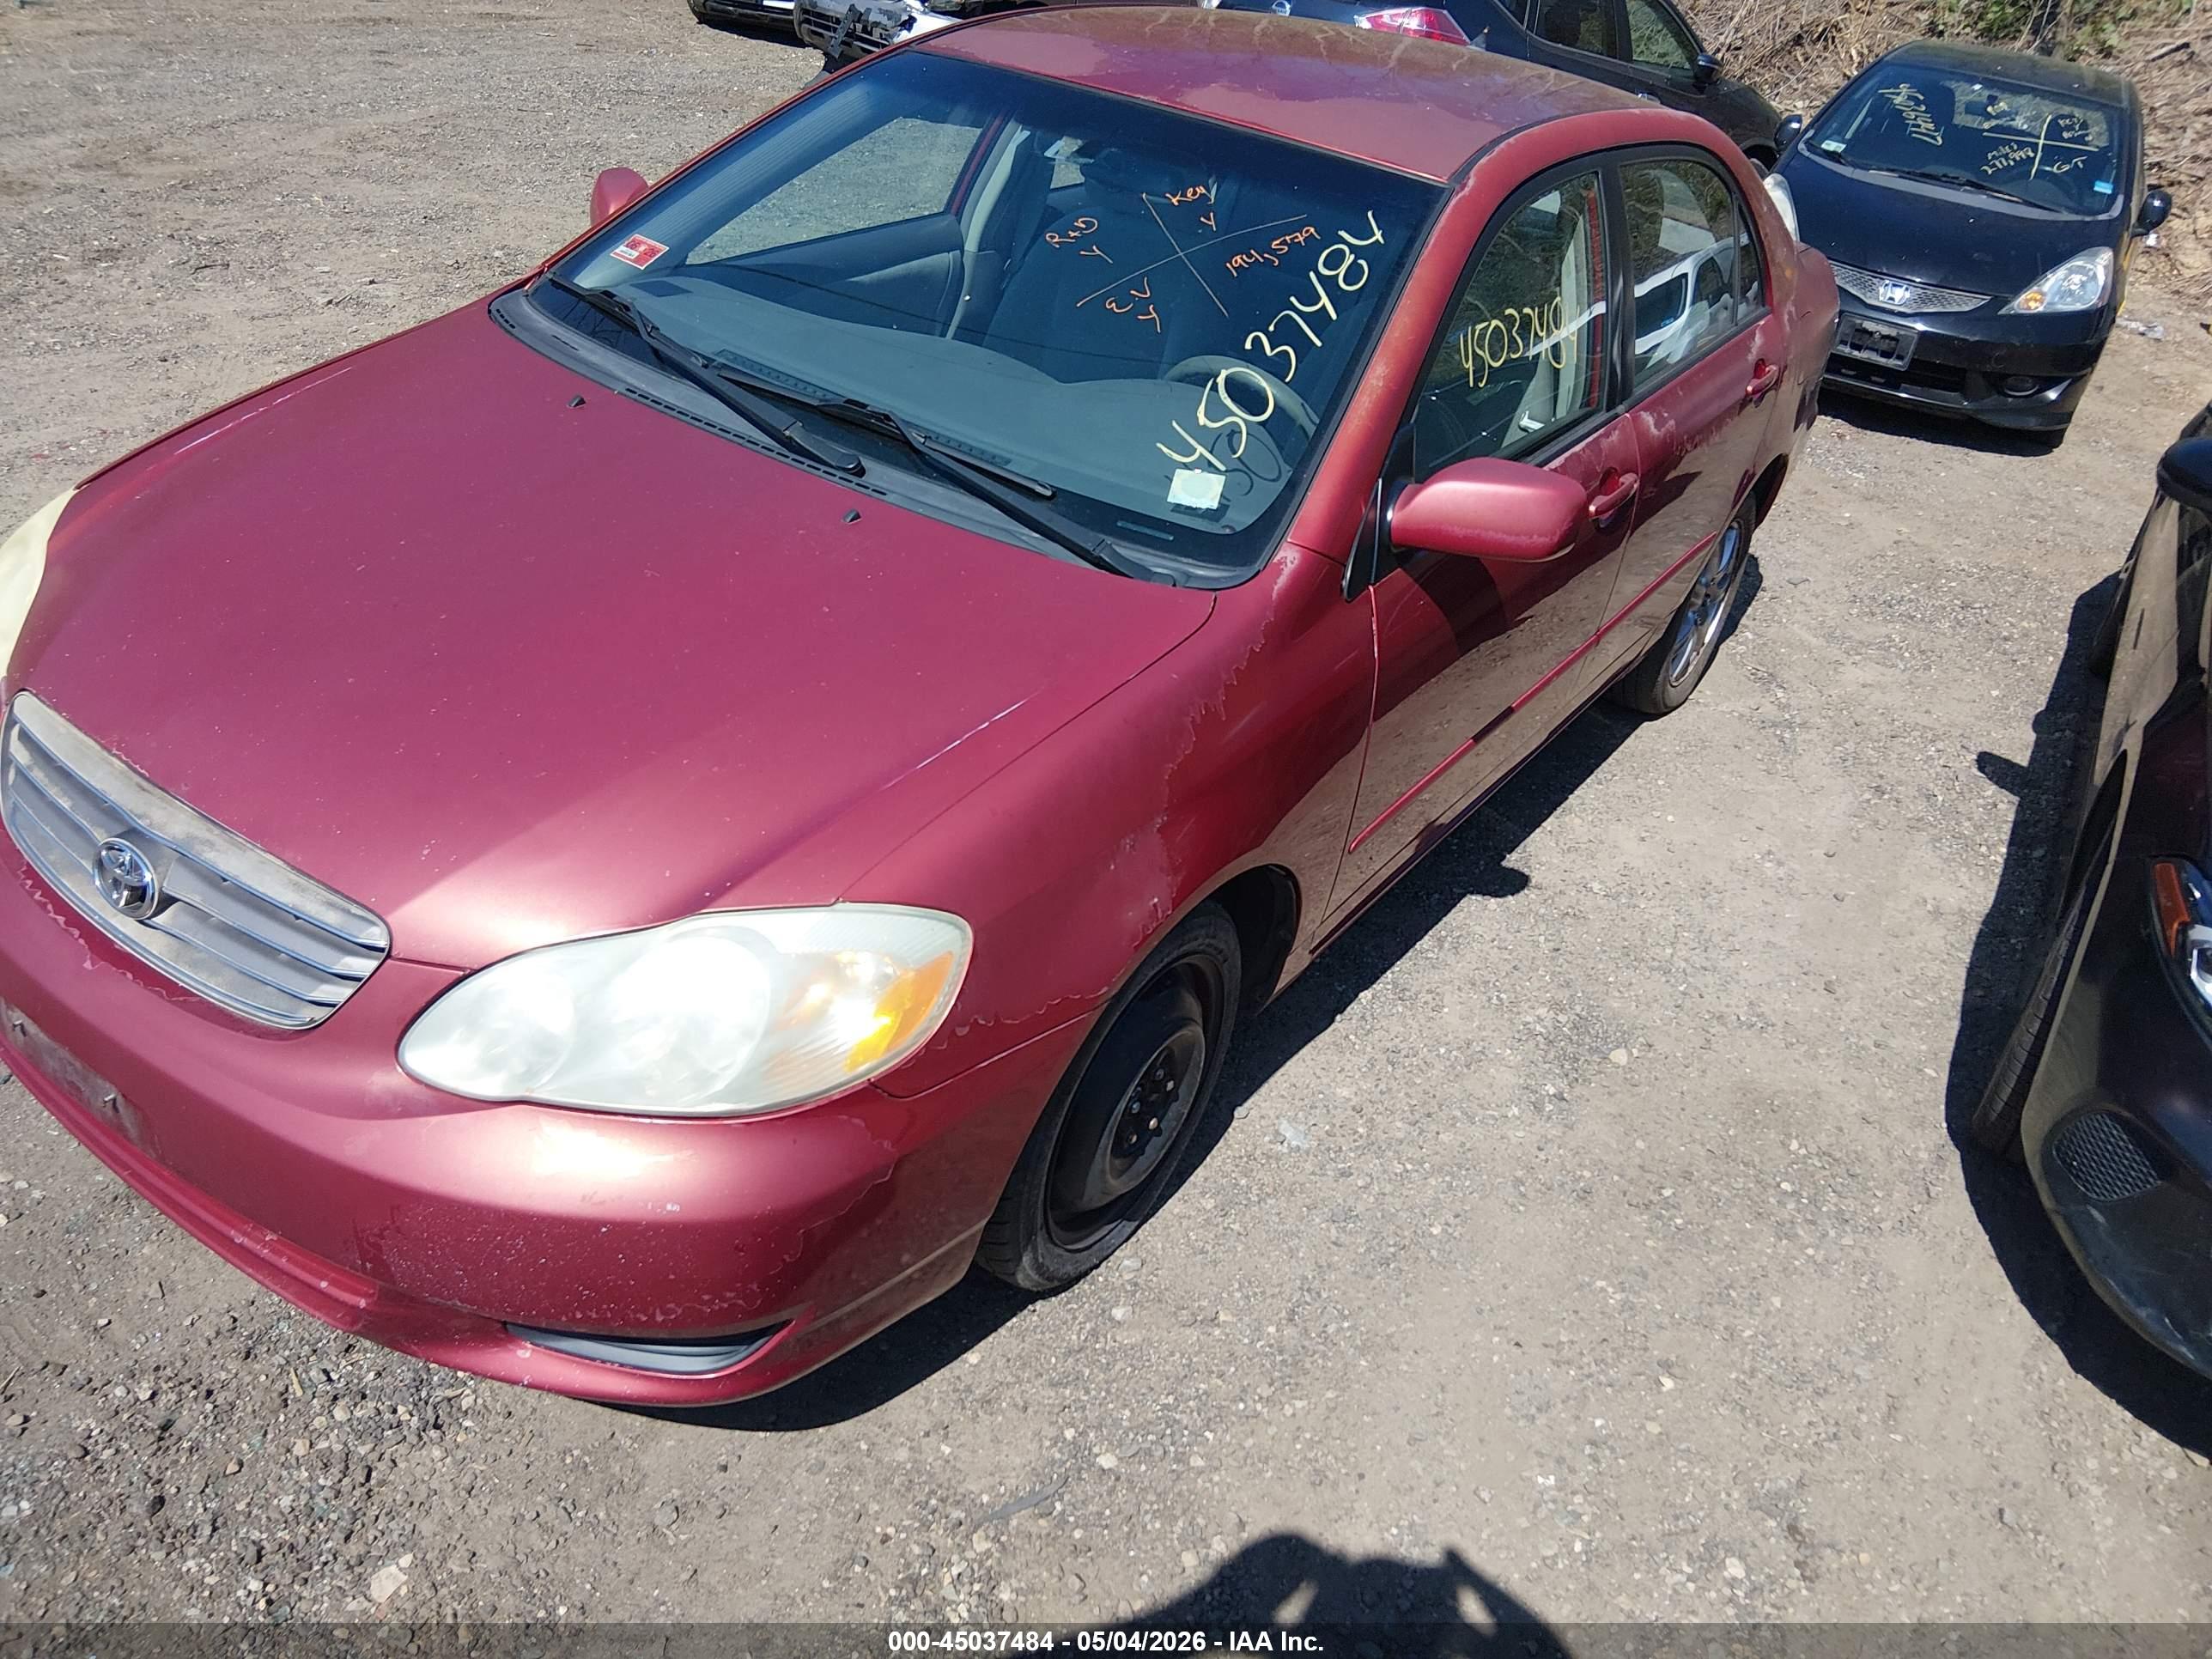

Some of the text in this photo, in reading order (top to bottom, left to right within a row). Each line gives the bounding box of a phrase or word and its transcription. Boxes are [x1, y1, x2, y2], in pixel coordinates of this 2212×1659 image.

[1165, 185, 1216, 206] Key
[1225, 226, 1322, 277] 194,579
[1155, 210, 1388, 471] 45037484
[1460, 295, 1581, 388] 45037484
